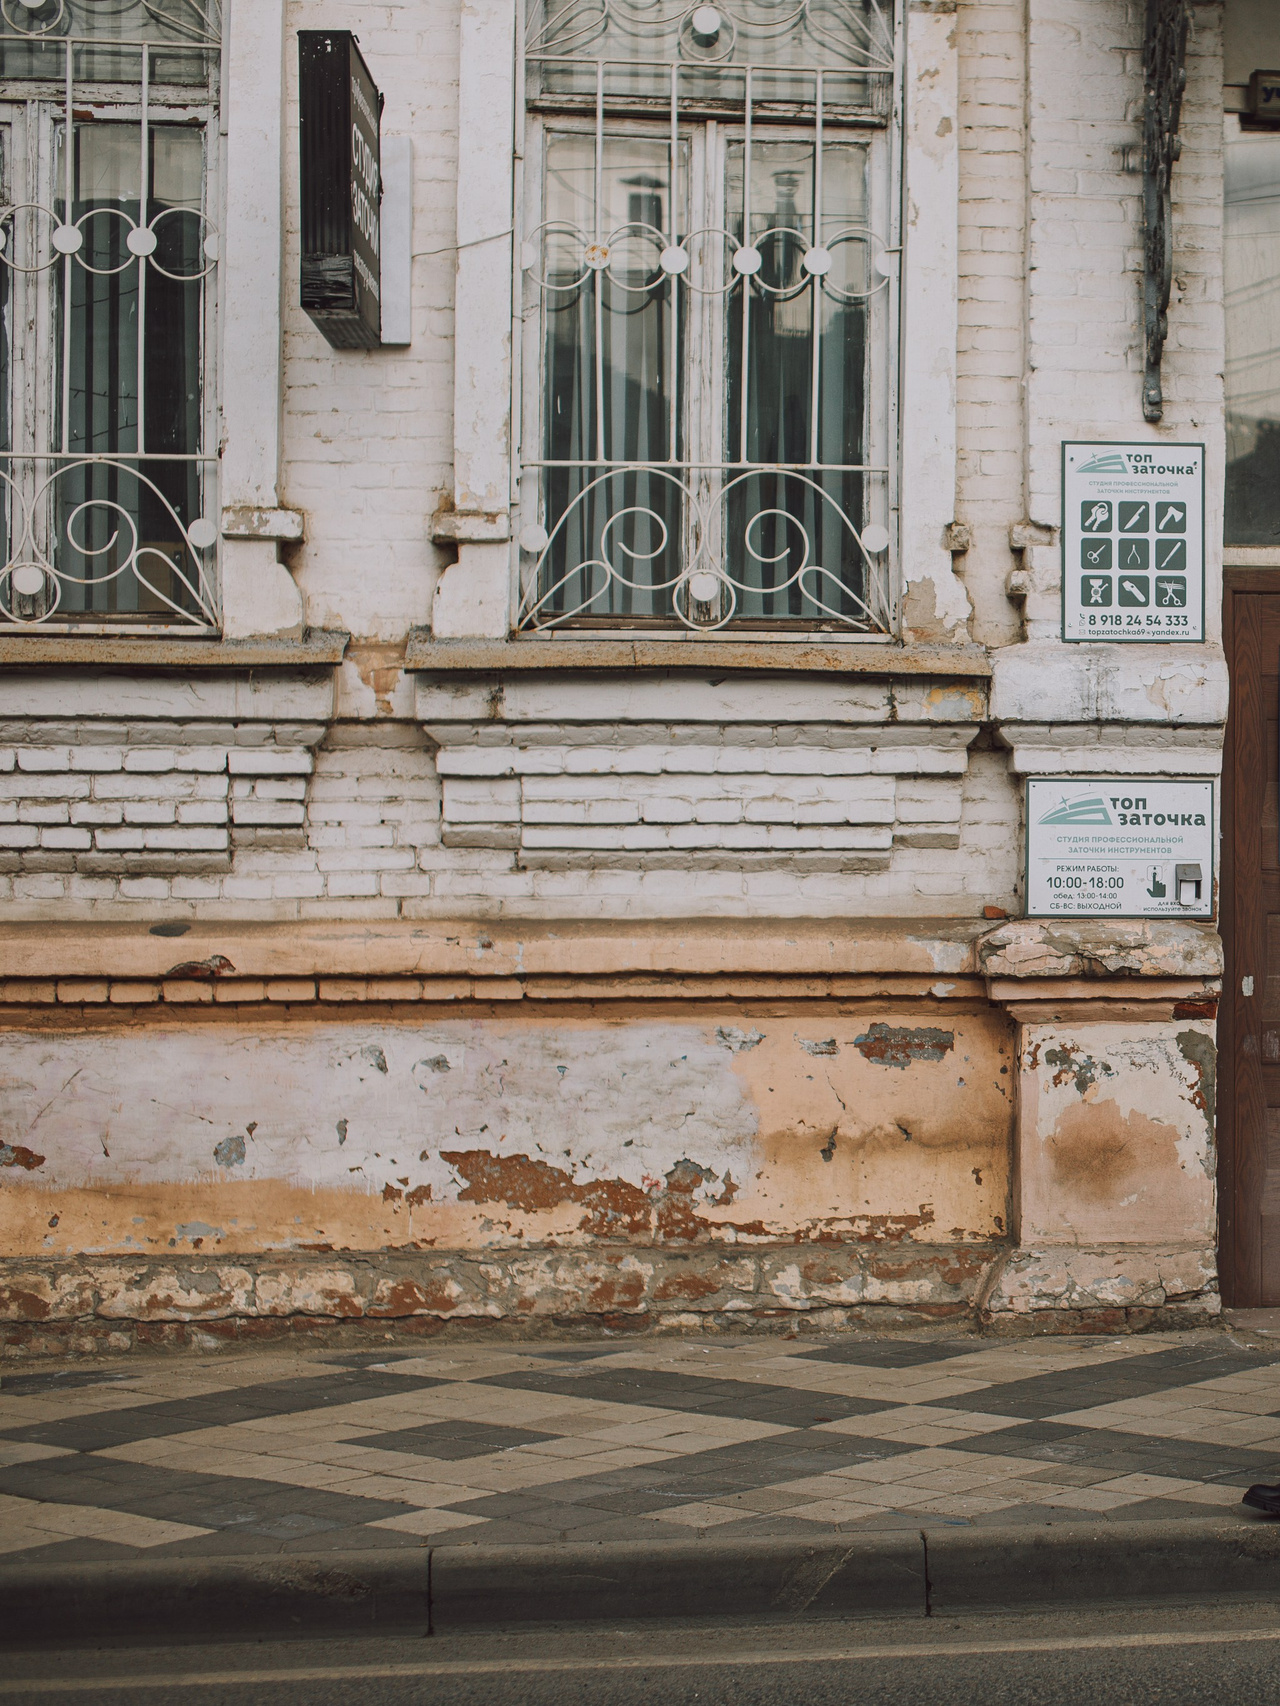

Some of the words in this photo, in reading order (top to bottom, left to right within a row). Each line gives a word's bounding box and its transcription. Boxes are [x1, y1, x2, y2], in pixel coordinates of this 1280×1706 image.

[353, 122, 379, 199] СТУДИЯ
[1089, 480, 1113, 488] СТУДИЯ
[1113, 480, 1178, 488] ПРОФЕССИОНАЛЬНОЙ
[1089, 615, 1097, 626] 8
[1100, 615, 1122, 626] 918
[1126, 615, 1142, 626] 24
[1146, 615, 1161, 626] 54
[1165, 615, 1188, 627] 333
[1057, 836, 1089, 844] СТУДИЯ
[1091, 835, 1184, 844] ПРОФЕССИОНАЛЬНОЙ
[1068, 847, 1106, 855] ЗАТОЧКИ
[1107, 847, 1172, 855] ИНСТРУМЕНТОВ
[1057, 865, 1085, 873] РЕЖИМ
[1087, 865, 1120, 873] РАБОТЫ:
[1046, 877, 1124, 889] 10:00-18:00
[1053, 892, 1074, 900] обед:
[1076, 892, 1118, 900] 13:00-14:00
[1049, 902, 1075, 910] СБ-ВС:
[1077, 902, 1122, 911] ВЫХОДНОЙ
